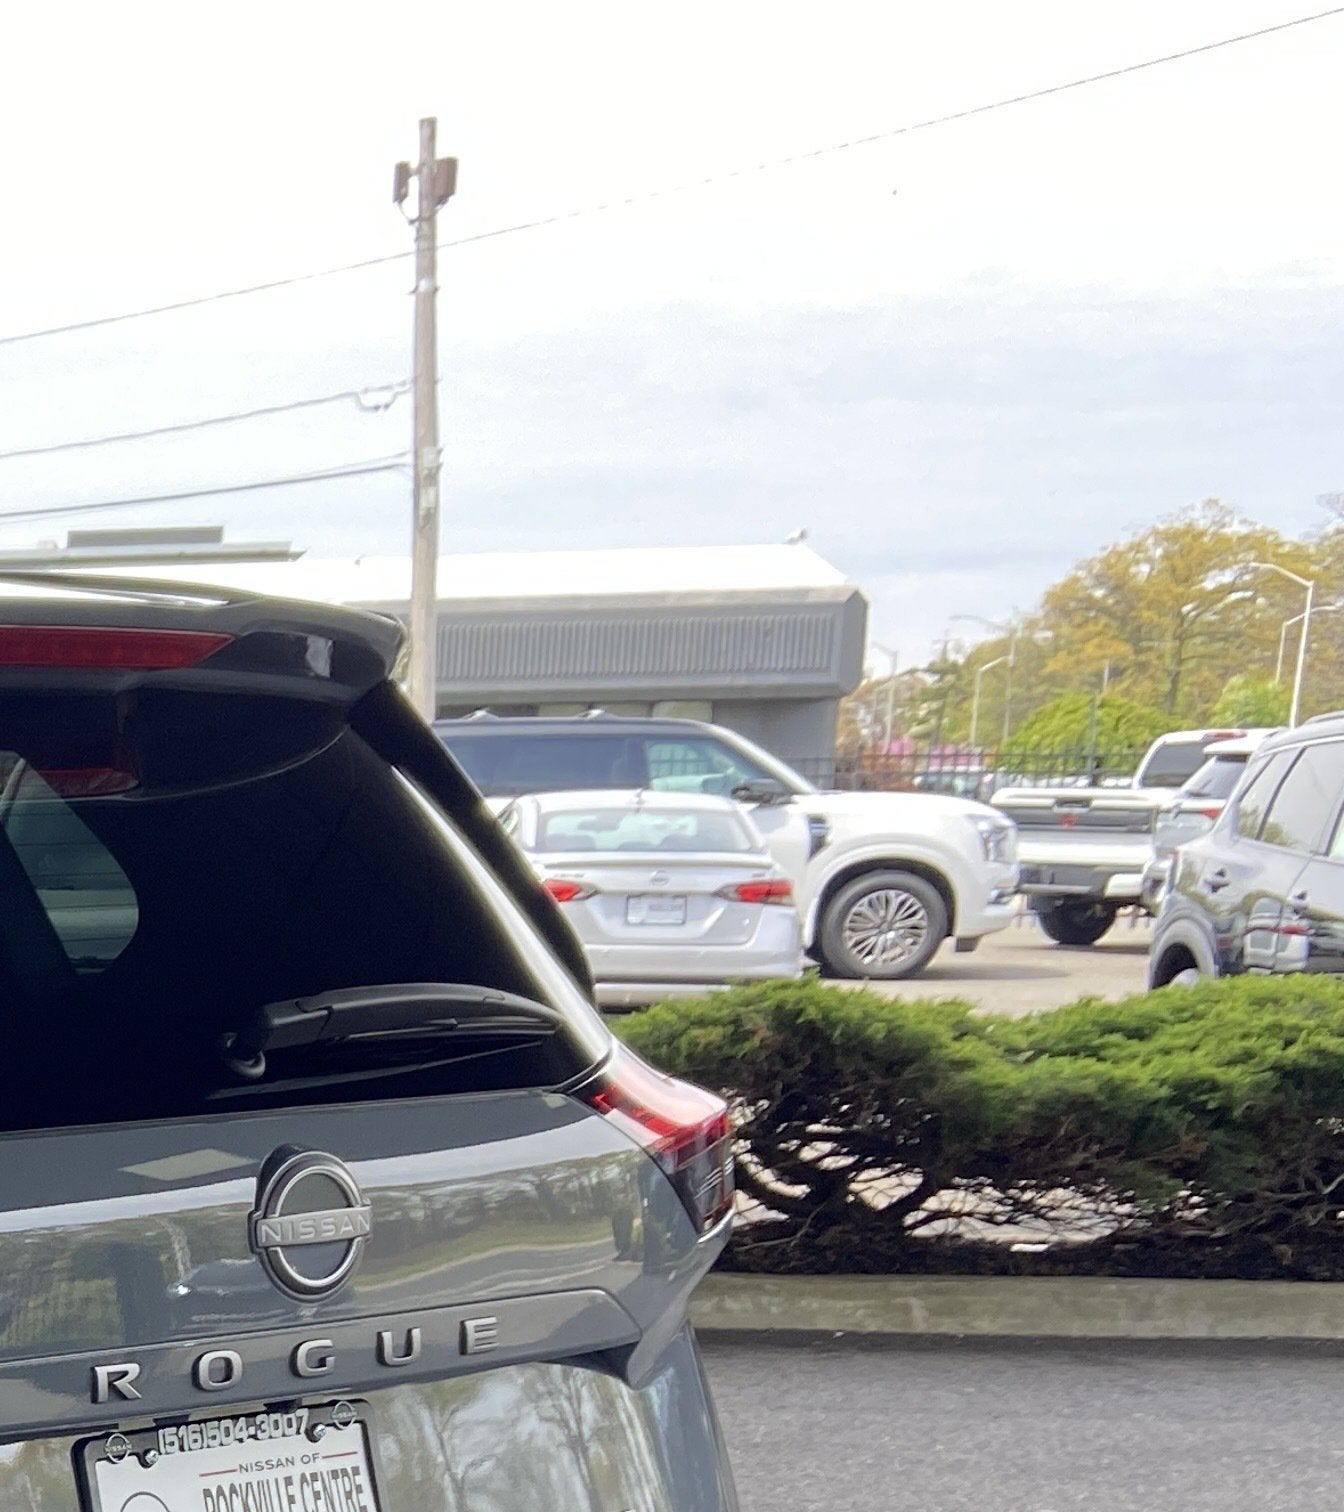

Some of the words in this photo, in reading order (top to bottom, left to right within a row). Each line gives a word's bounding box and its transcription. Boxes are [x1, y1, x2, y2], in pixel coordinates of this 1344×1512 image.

[261, 1214, 370, 1243] NISSAN
[91, 1315, 499, 1403] ROGUE
[158, 1408, 310, 1455] (516)504-3007
[238, 1456, 296, 1473] NISSAN
[300, 1452, 321, 1465] OF
